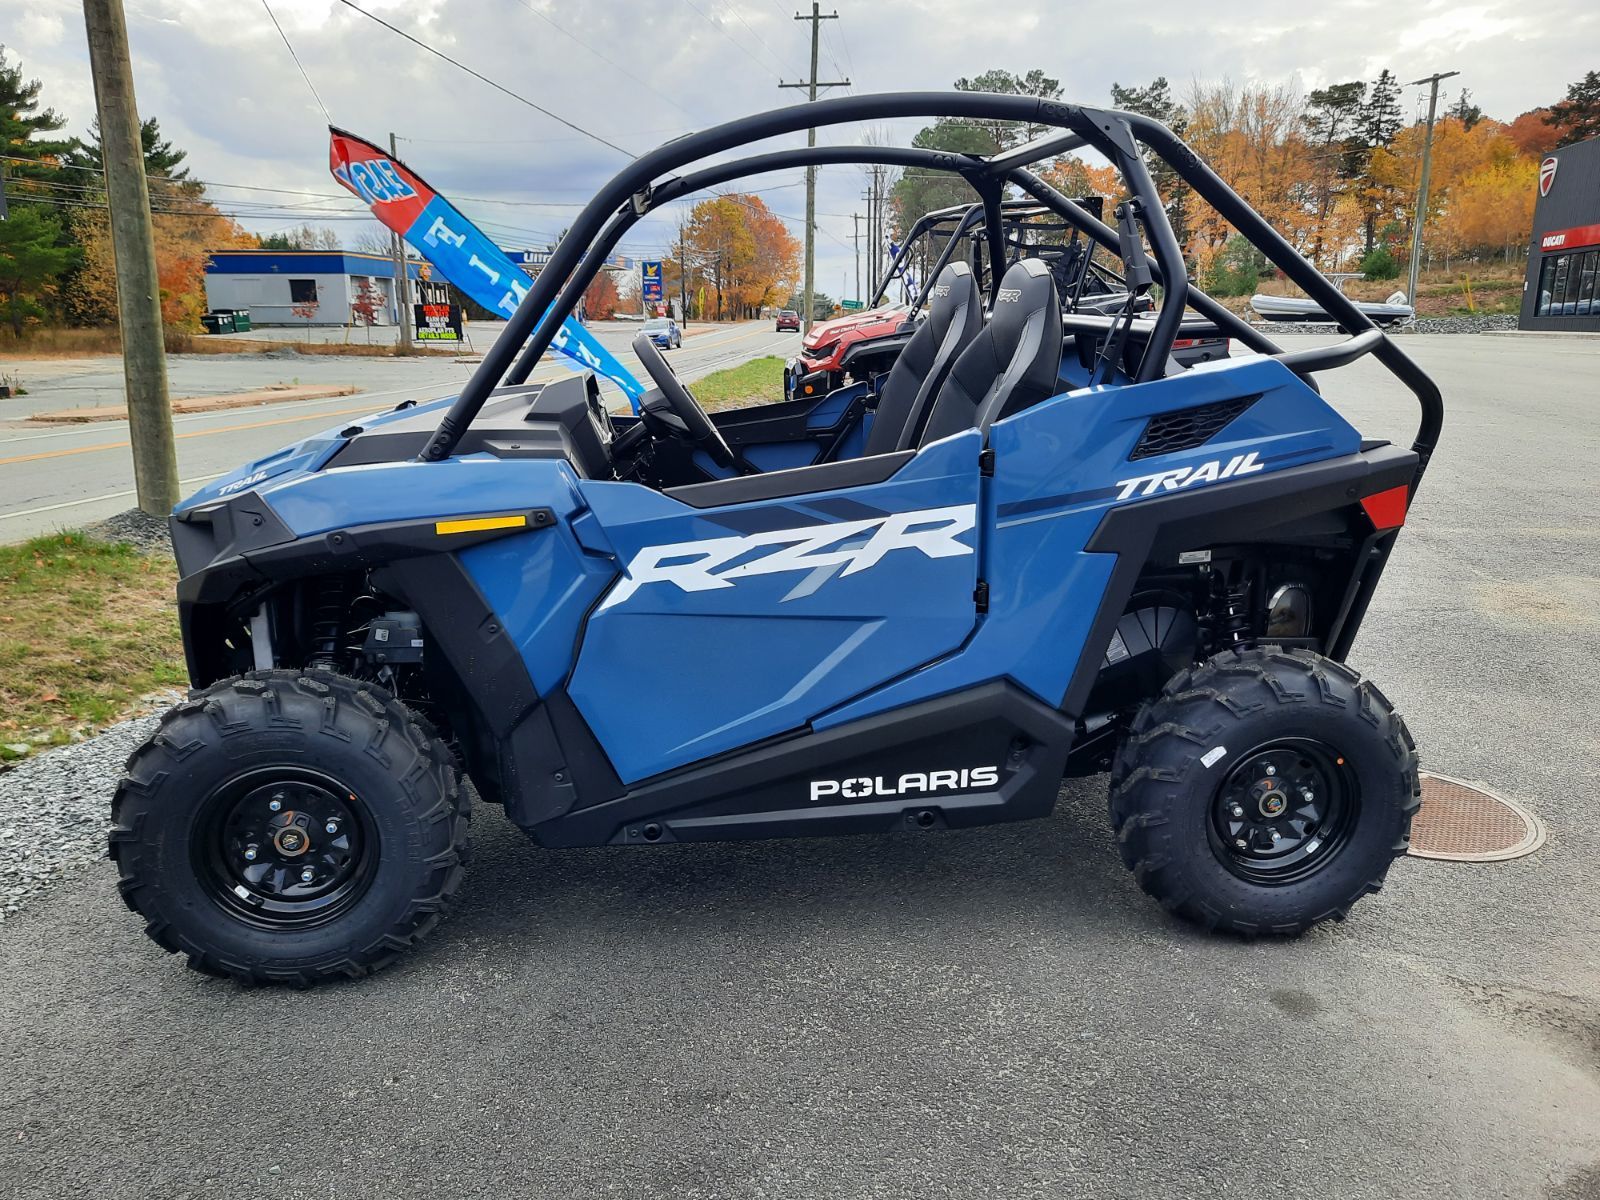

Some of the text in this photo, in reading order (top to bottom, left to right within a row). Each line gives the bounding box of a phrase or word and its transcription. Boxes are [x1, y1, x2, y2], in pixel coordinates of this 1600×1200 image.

[1542, 234, 1565, 247] DUCATI
[219, 471, 268, 496] TRAIL
[1115, 451, 1265, 500] TRAIL
[599, 503, 977, 611] RZR
[810, 766, 999, 800] POLARIS
